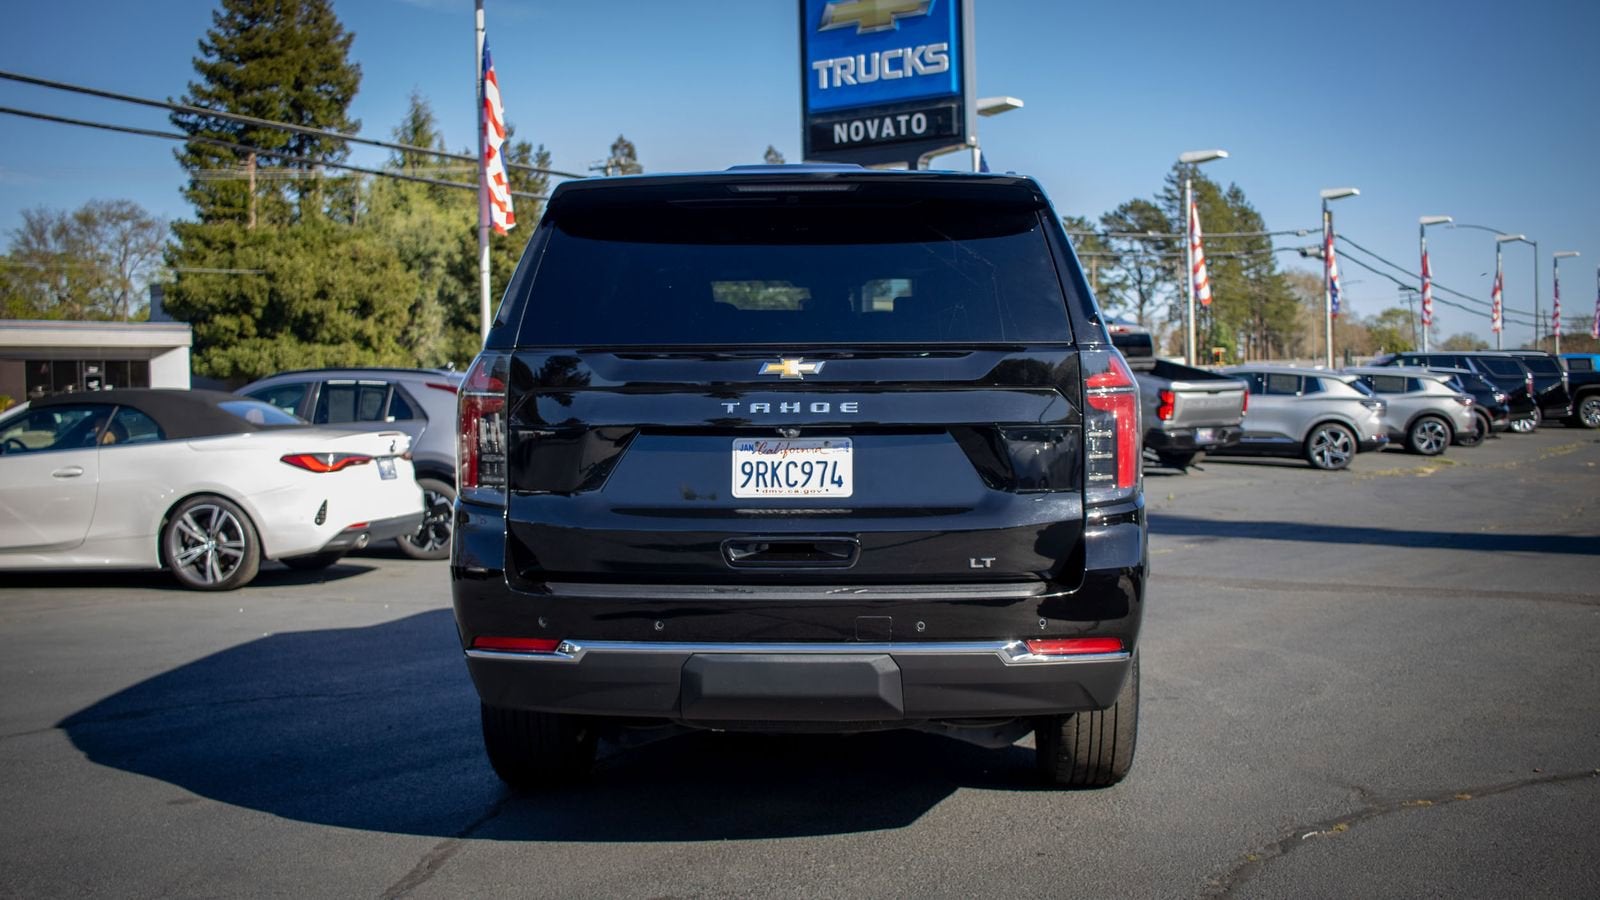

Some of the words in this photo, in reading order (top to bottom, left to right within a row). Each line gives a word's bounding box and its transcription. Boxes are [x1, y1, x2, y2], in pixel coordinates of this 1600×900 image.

[812, 42, 950, 89] TRUCKS
[833, 113, 927, 144] NOVATO
[721, 402, 859, 414] TAHOE
[740, 443, 754, 452] JAN
[753, 441, 830, 459] California
[740, 460, 844, 489] 9RKC974
[969, 557, 996, 569] LT
